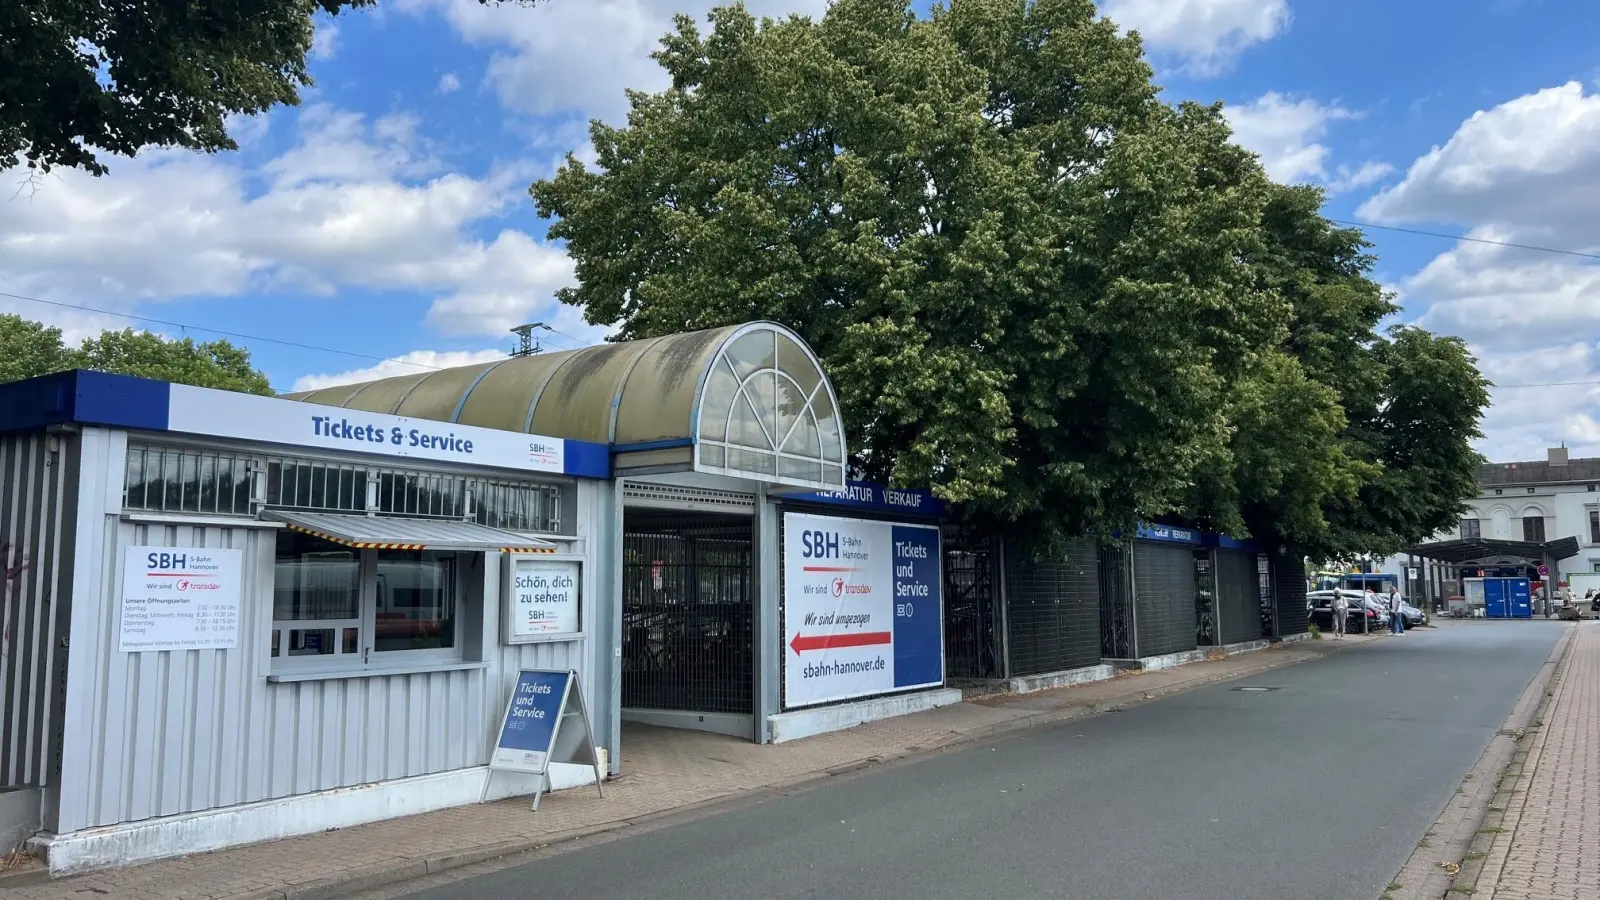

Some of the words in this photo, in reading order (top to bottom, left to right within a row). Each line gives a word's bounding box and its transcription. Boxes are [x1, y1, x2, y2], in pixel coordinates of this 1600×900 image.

[312, 416, 384, 443] Tickets
[391, 427, 403, 445] &
[409, 429, 473, 454] Service
[530, 443, 544, 453] SBH
[882, 490, 922, 508] VERKAUF
[802, 530, 838, 559] SBH
[842, 537, 862, 546] S-Bahn
[842, 550, 869, 560] Hannover
[896, 541, 927, 558] Tickets
[148, 552, 186, 569] SBH
[897, 561, 913, 578] und
[516, 575, 550, 589] Schön,
[552, 575, 572, 588] dich
[804, 585, 814, 594] Wir
[815, 584, 827, 594] sind
[845, 584, 872, 594] transdev
[897, 581, 928, 597] Service
[520, 594, 532, 603] zu
[535, 590, 568, 602] sehen!
[529, 610, 544, 620] SBH
[804, 612, 818, 626] Wir
[818, 610, 834, 625] sind
[836, 614, 870, 628] umgezogen
[804, 656, 885, 678] sbahn-hannover.de
[520, 682, 551, 694] Tickets
[516, 695, 534, 705] und
[512, 706, 545, 718] Service
